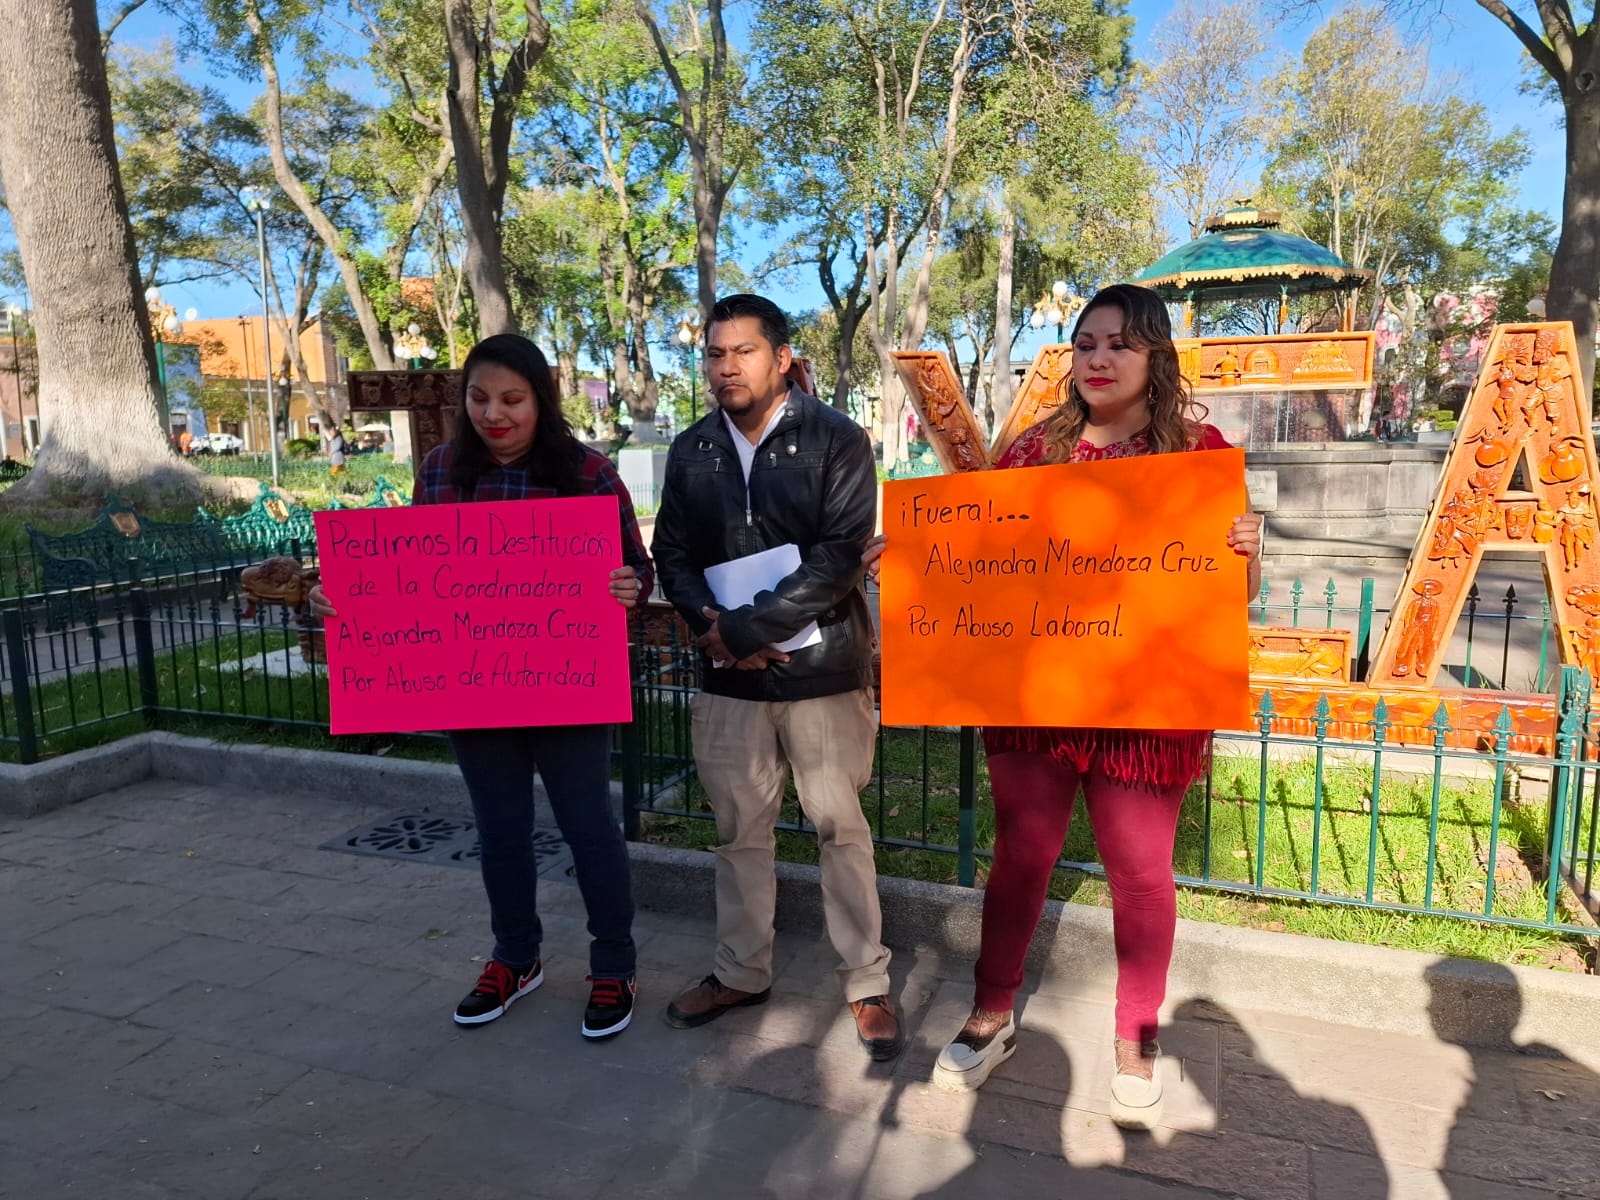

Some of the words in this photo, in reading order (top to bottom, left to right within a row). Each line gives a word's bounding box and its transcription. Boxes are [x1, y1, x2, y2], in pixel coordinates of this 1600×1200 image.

[328, 517, 450, 559] Pedimos
[456, 507, 478, 556] la
[488, 507, 613, 557] Destitución
[350, 571, 379, 596] de
[397, 565, 418, 597] la
[433, 564, 582, 599] Coordinadora
[924, 542, 1037, 584] Alejandra
[1044, 537, 1152, 574] Mendoza
[1161, 541, 1218, 573] Cruz
[337, 618, 442, 656] Alejandra
[454, 611, 539, 641] Mendoza
[547, 608, 601, 640] Cruz
[908, 605, 940, 636] Por
[953, 603, 1013, 638] Abuso
[1030, 601, 1123, 637] Laboral.
[342, 666, 376, 692] Por
[386, 662, 447, 693] Abuso
[458, 650, 485, 686] de
